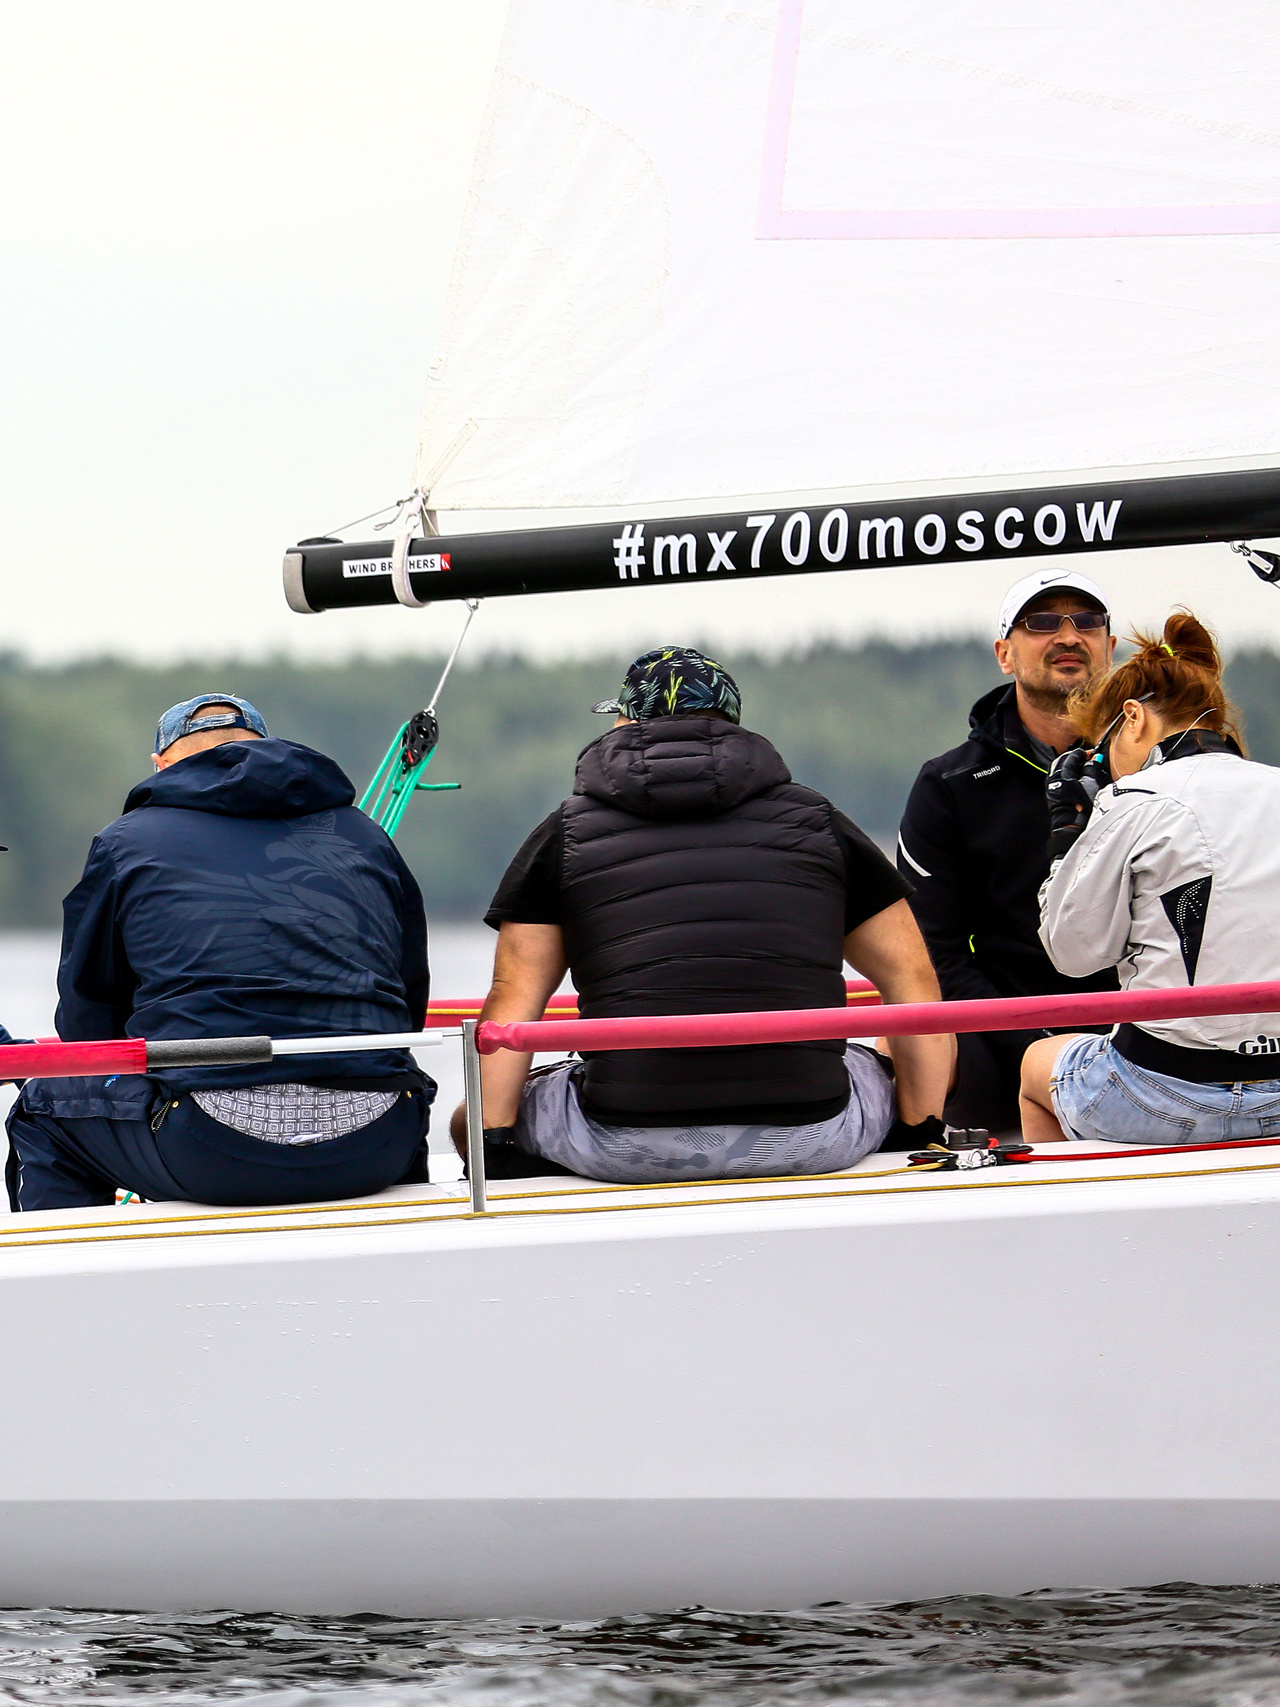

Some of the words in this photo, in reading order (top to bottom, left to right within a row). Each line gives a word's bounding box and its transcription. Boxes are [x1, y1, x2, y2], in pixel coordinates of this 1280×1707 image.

[612, 499, 1123, 579] #mx700moscow
[348, 563, 377, 574] WIND
[381, 558, 436, 572] BRHERS
